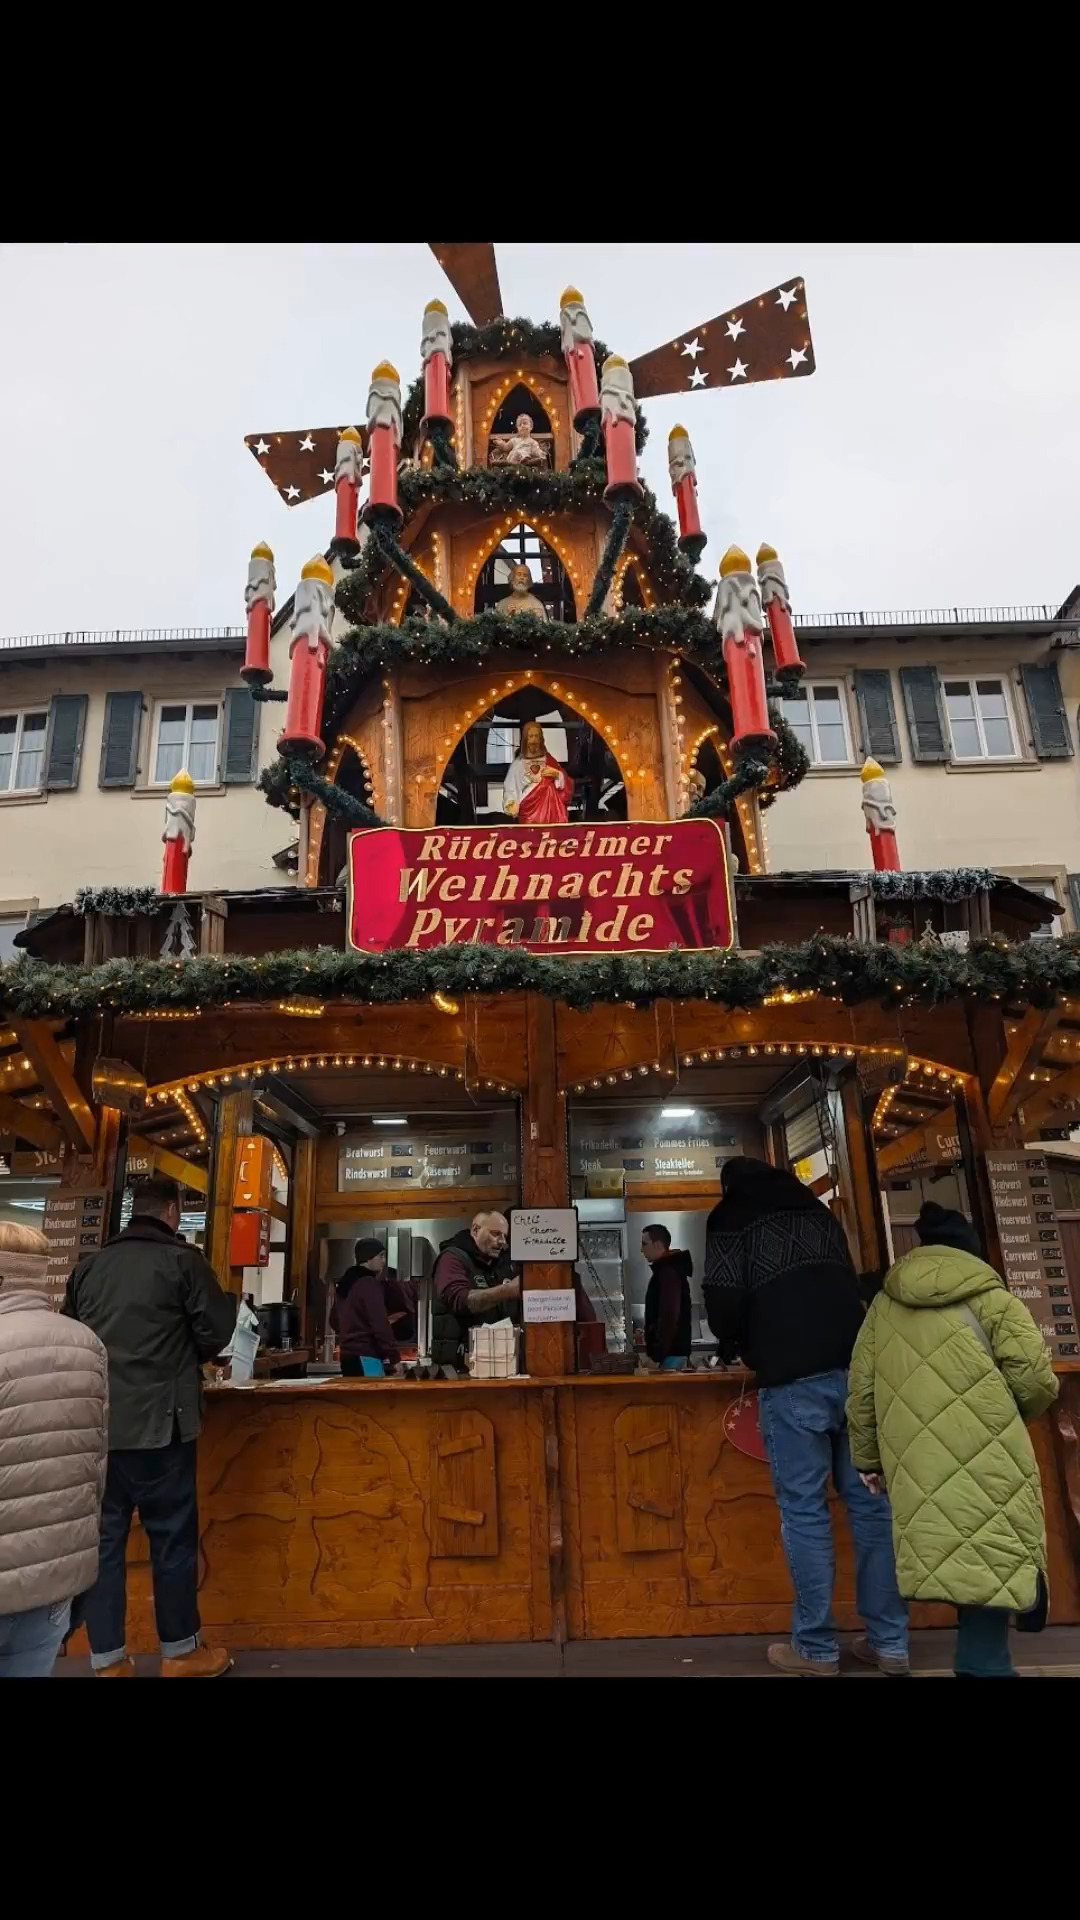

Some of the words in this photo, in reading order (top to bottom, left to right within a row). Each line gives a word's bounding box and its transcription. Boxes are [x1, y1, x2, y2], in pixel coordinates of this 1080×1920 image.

[416, 831, 673, 862] Rüdesheimer
[397, 862, 694, 903] Weihnachts
[405, 905, 655, 948] Pyramide
[654, 1137, 686, 1149] Pommes
[688, 1136, 710, 1148] Frites
[936, 1134, 960, 1149] Curr
[345, 1146, 384, 1159] Bratwurst
[424, 1143, 467, 1157] Feuerwurst
[580, 1158, 602, 1171] Steak
[655, 1157, 696, 1169] Steakteller
[989, 1160, 1018, 1172] Bratwurst
[345, 1166, 388, 1180] Rindswurst
[992, 1178, 1022, 1190] Bratwurst
[46, 1199, 76, 1211] Bratwurst
[995, 1196, 1028, 1207] Rindswurst
[998, 1213, 1032, 1225] Feuerwurst
[1004, 1250, 1038, 1263] Currywurst
[1007, 1268, 1042, 1282] Currywurst
